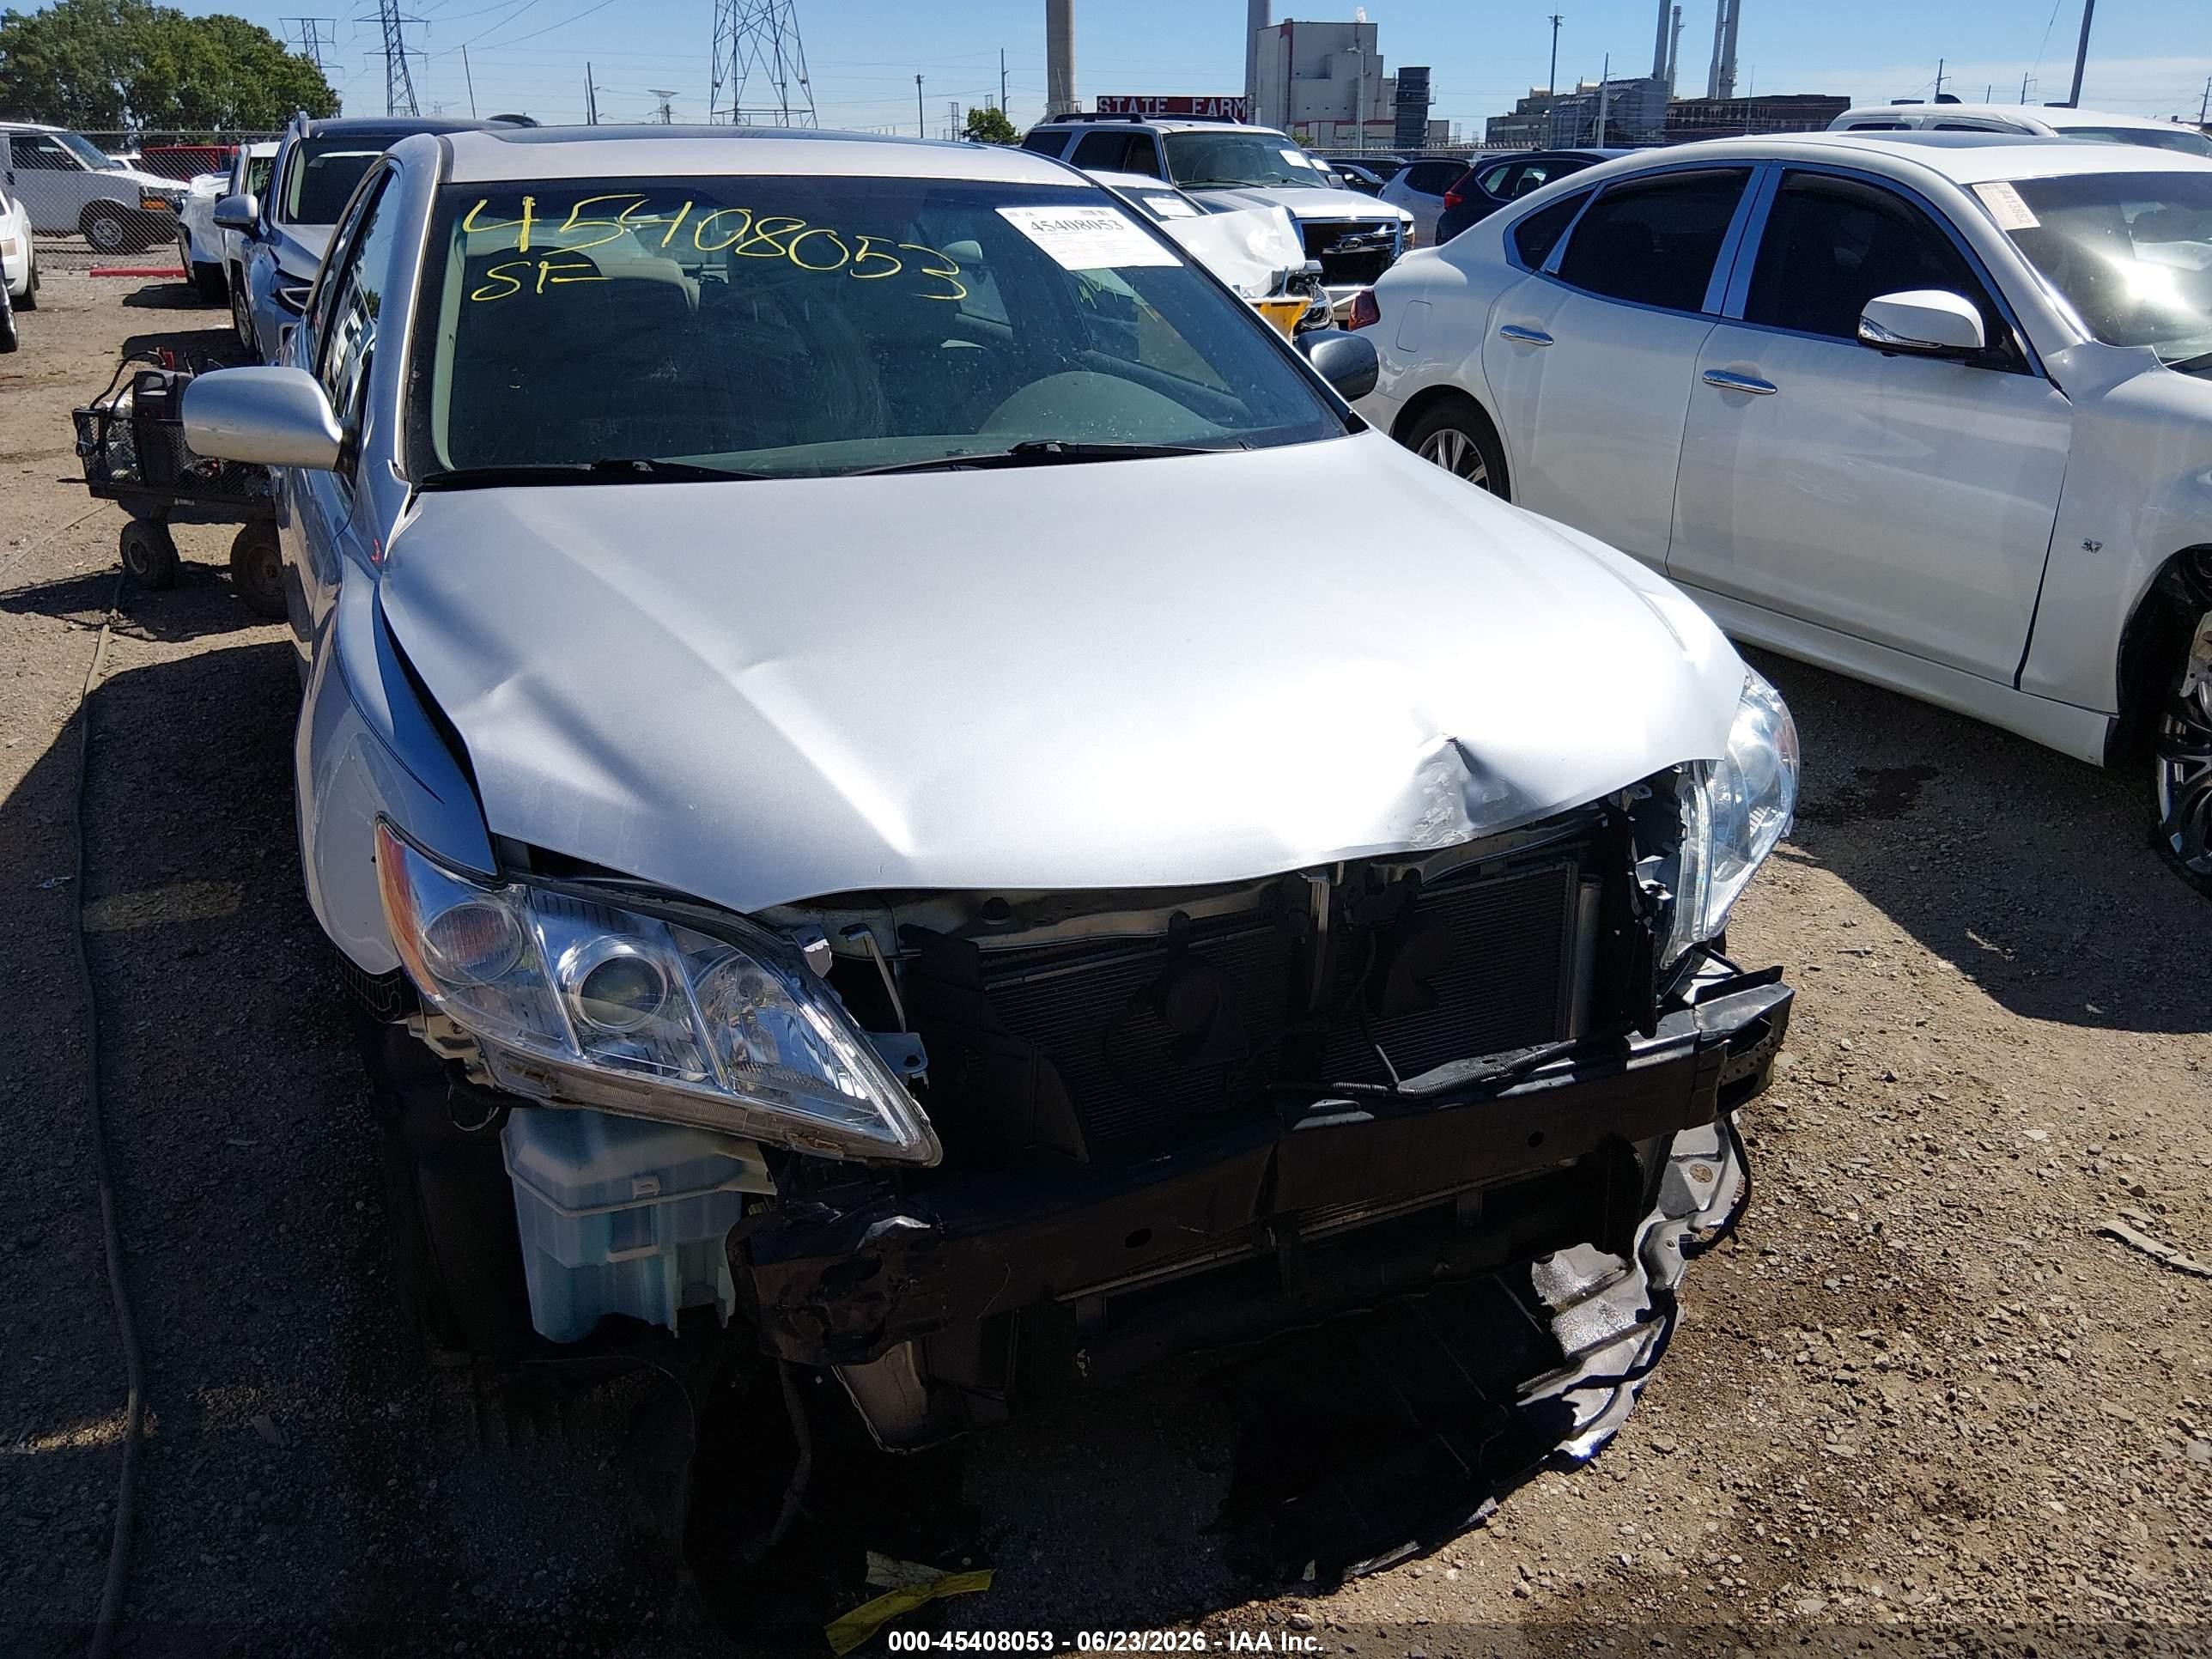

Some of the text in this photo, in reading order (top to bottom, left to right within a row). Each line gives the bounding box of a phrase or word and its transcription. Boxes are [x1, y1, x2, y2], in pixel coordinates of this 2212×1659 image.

[1097, 97, 1246, 117] STATE FARM
[1030, 219, 1125, 232] 45408053
[461, 193, 968, 301] 45408053
[471, 260, 613, 301] SF
